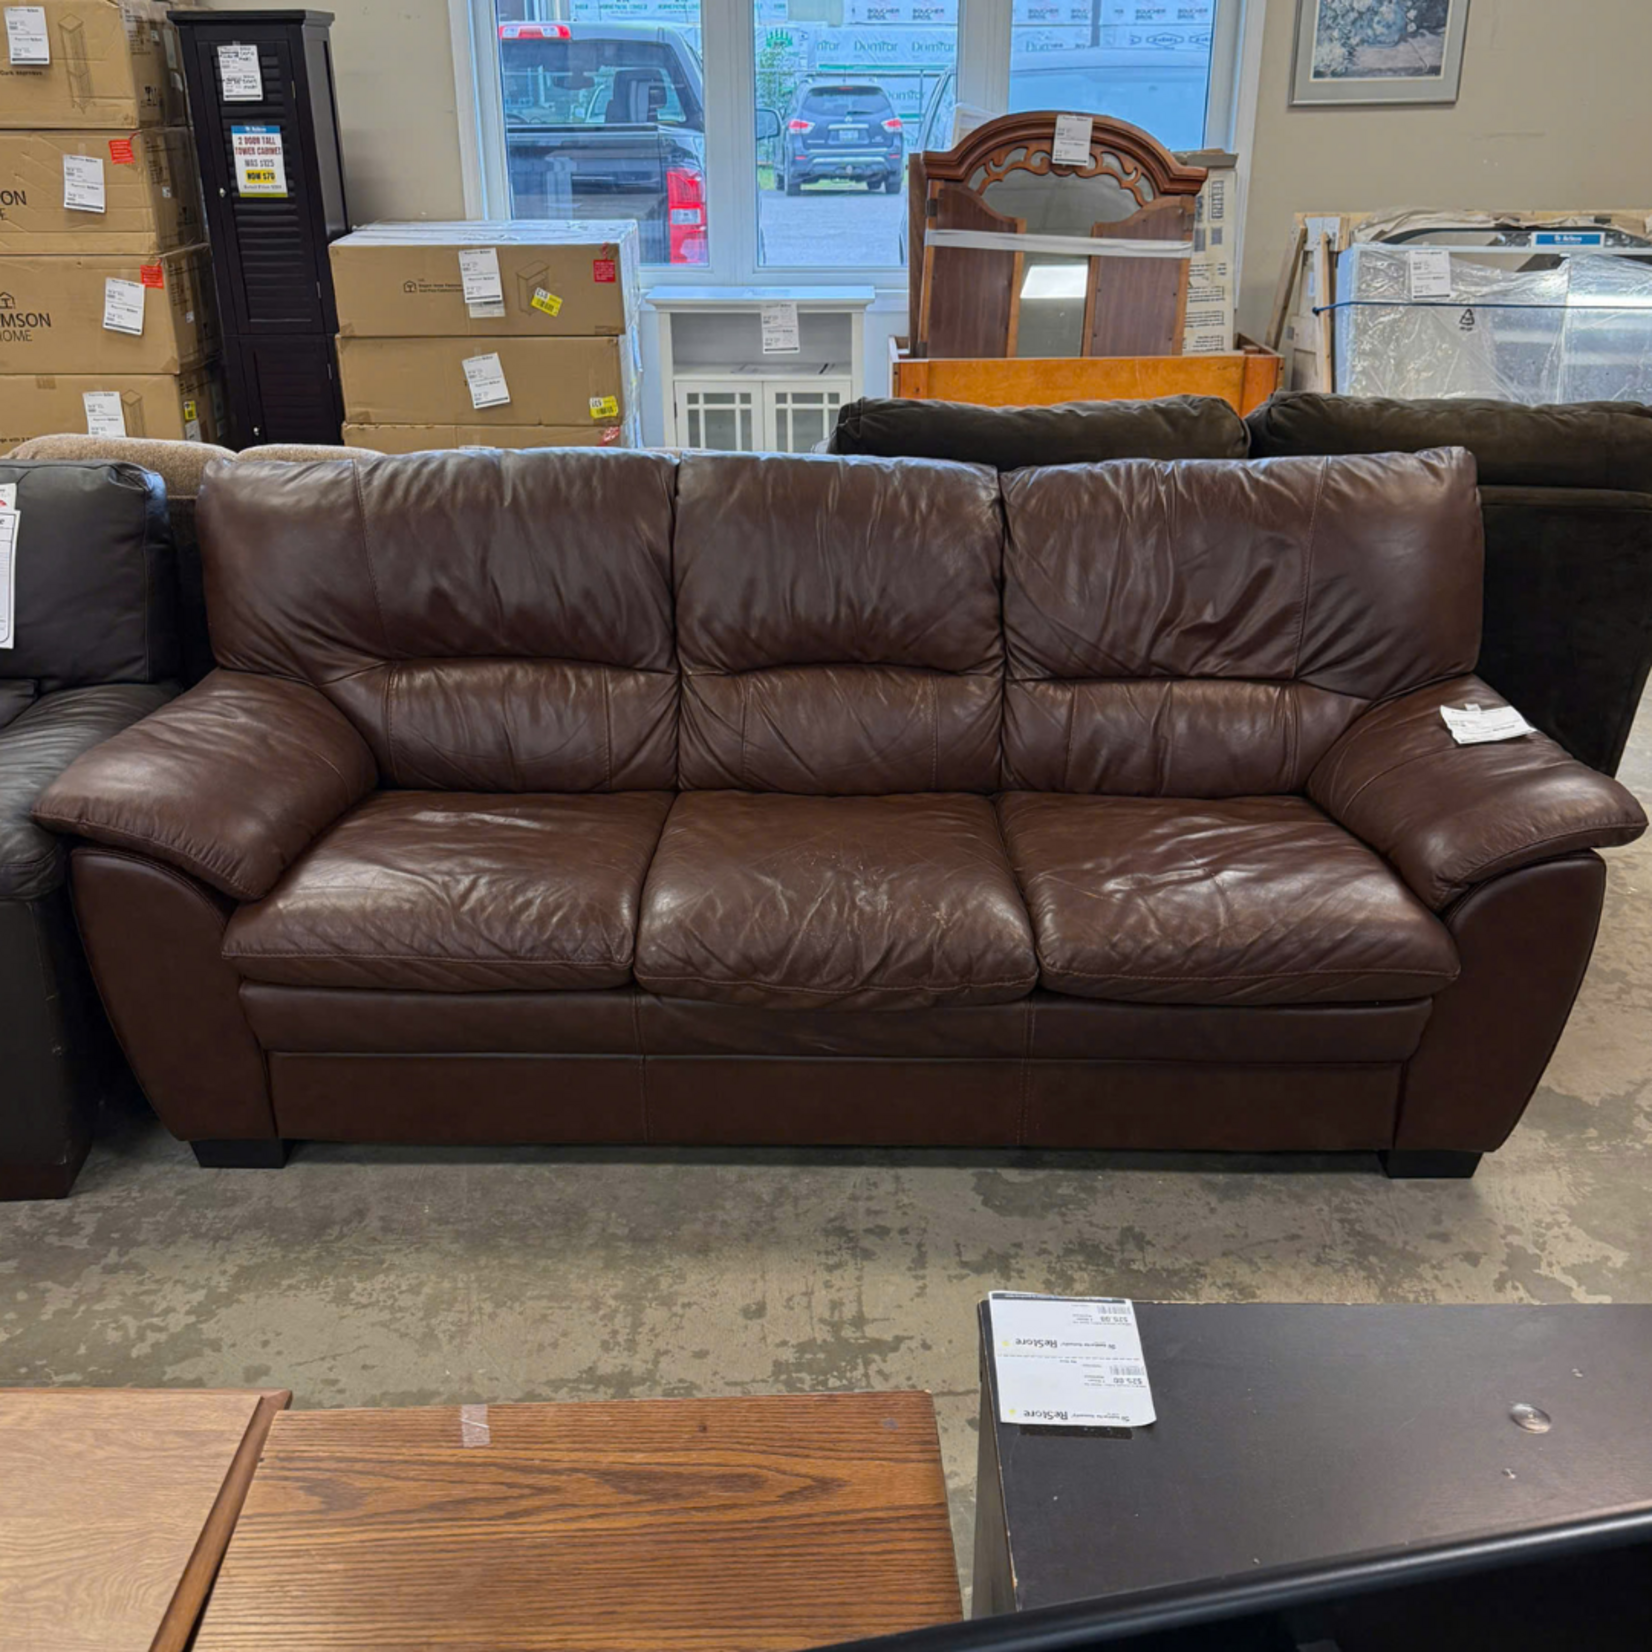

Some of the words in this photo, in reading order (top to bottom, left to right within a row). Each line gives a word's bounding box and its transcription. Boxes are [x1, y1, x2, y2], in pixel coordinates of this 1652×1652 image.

[854, 41, 898, 51] Domtar
[262, 136, 276, 145] TALL
[247, 172, 261, 180] NOW
[1015, 1338, 1058, 1349] ReStore
[1023, 1409, 1069, 1420] ReStore
